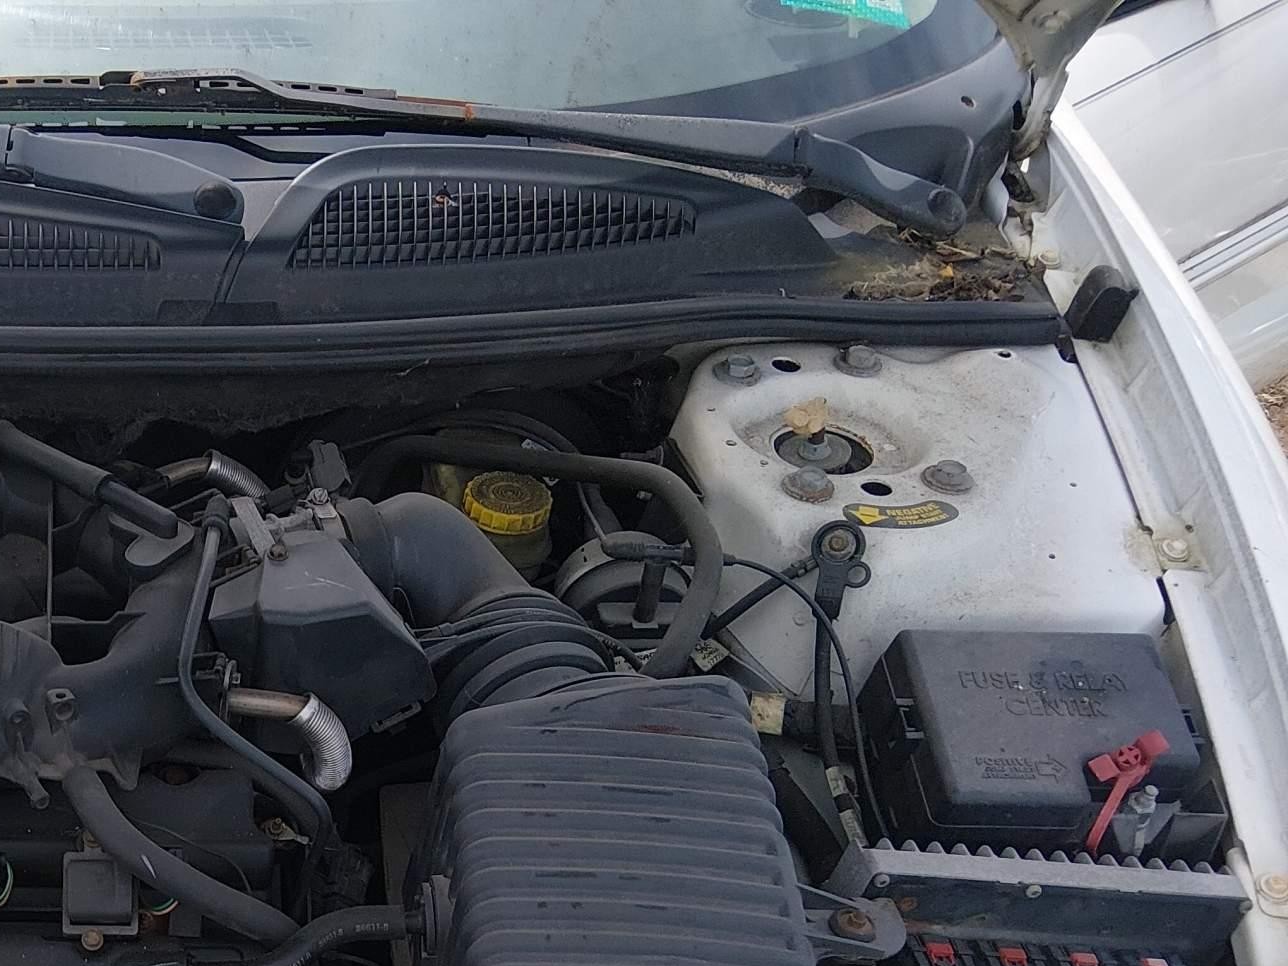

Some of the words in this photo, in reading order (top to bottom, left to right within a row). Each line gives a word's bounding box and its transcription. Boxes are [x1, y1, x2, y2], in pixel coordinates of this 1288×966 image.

[886, 503, 940, 517] NEGATIVE
[957, 669, 1020, 690] FUSE
[1053, 670, 1128, 692] RELAY
[1004, 696, 1108, 718] CENTER
